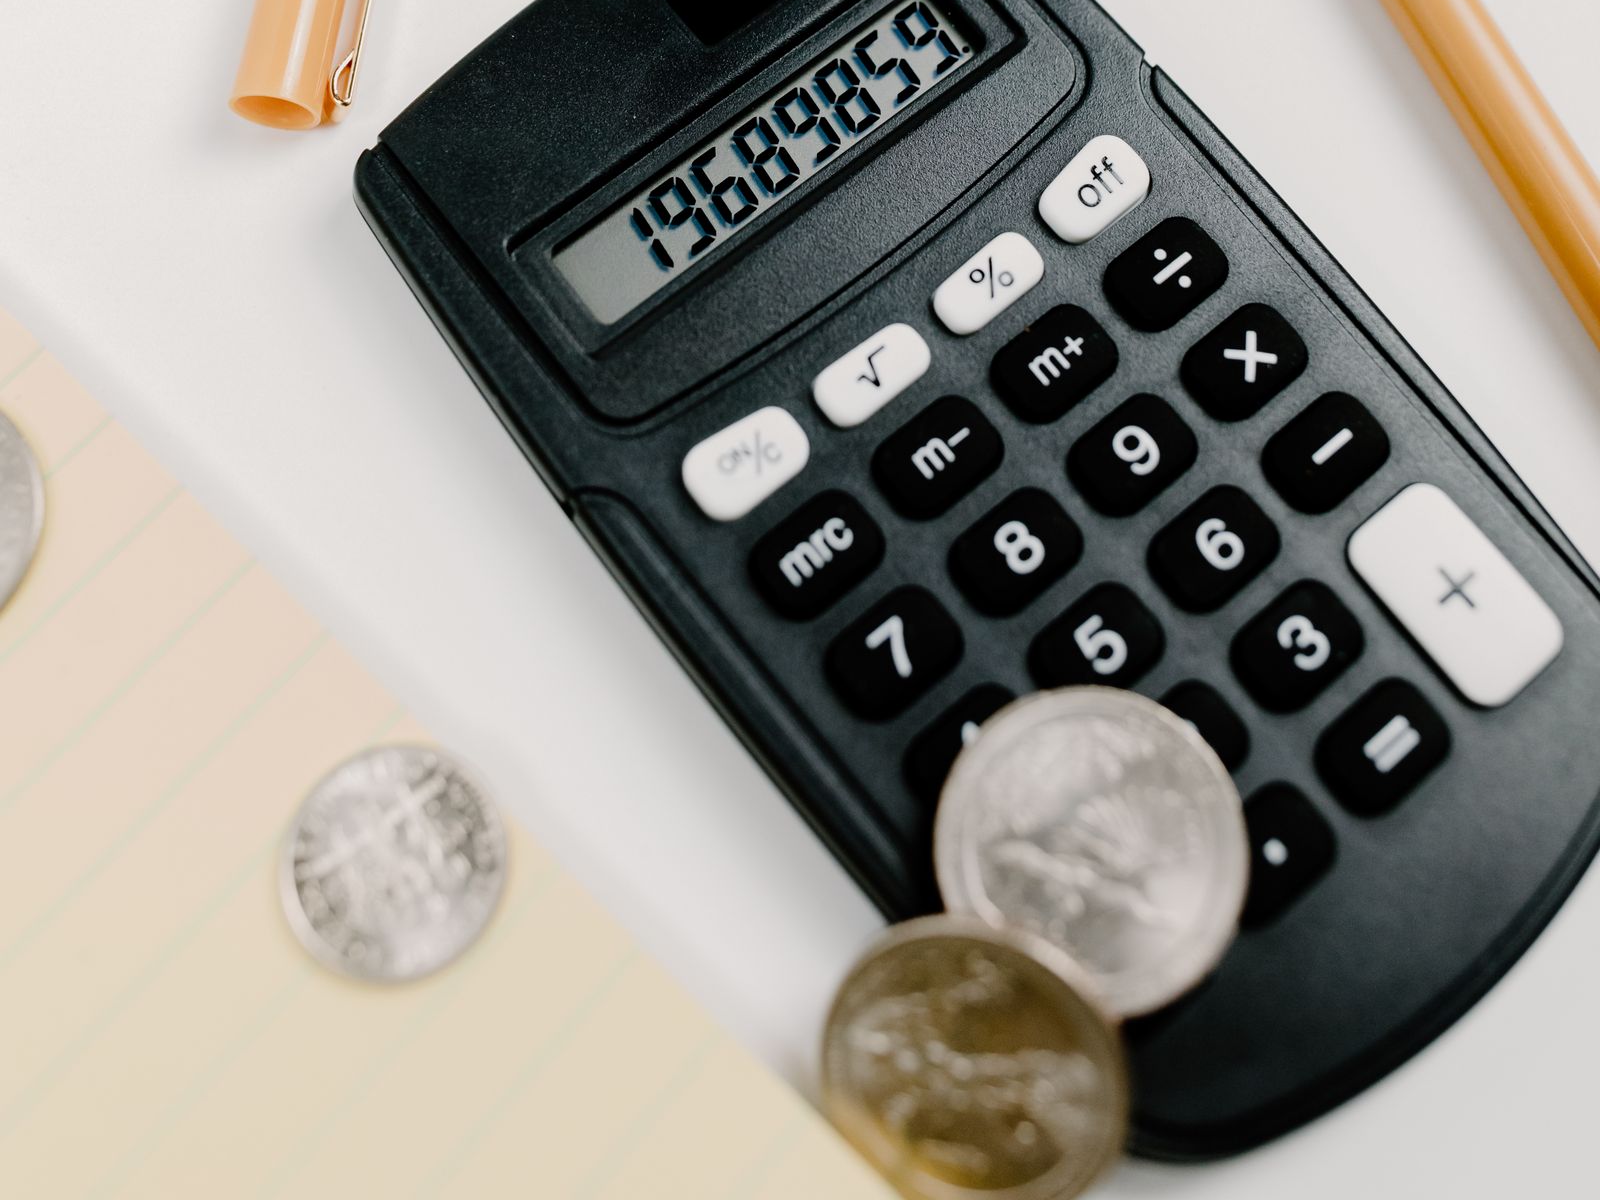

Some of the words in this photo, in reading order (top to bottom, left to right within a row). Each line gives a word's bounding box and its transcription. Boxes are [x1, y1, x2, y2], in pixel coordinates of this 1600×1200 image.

[1028, 335, 1084, 386] m+
[1112, 425, 1160, 475] 9
[778, 517, 854, 587] mrc
[993, 520, 1046, 575] 8
[1195, 518, 1245, 571] 6
[866, 615, 912, 677] 7
[1073, 615, 1128, 675] 5
[1277, 614, 1331, 671] 3
